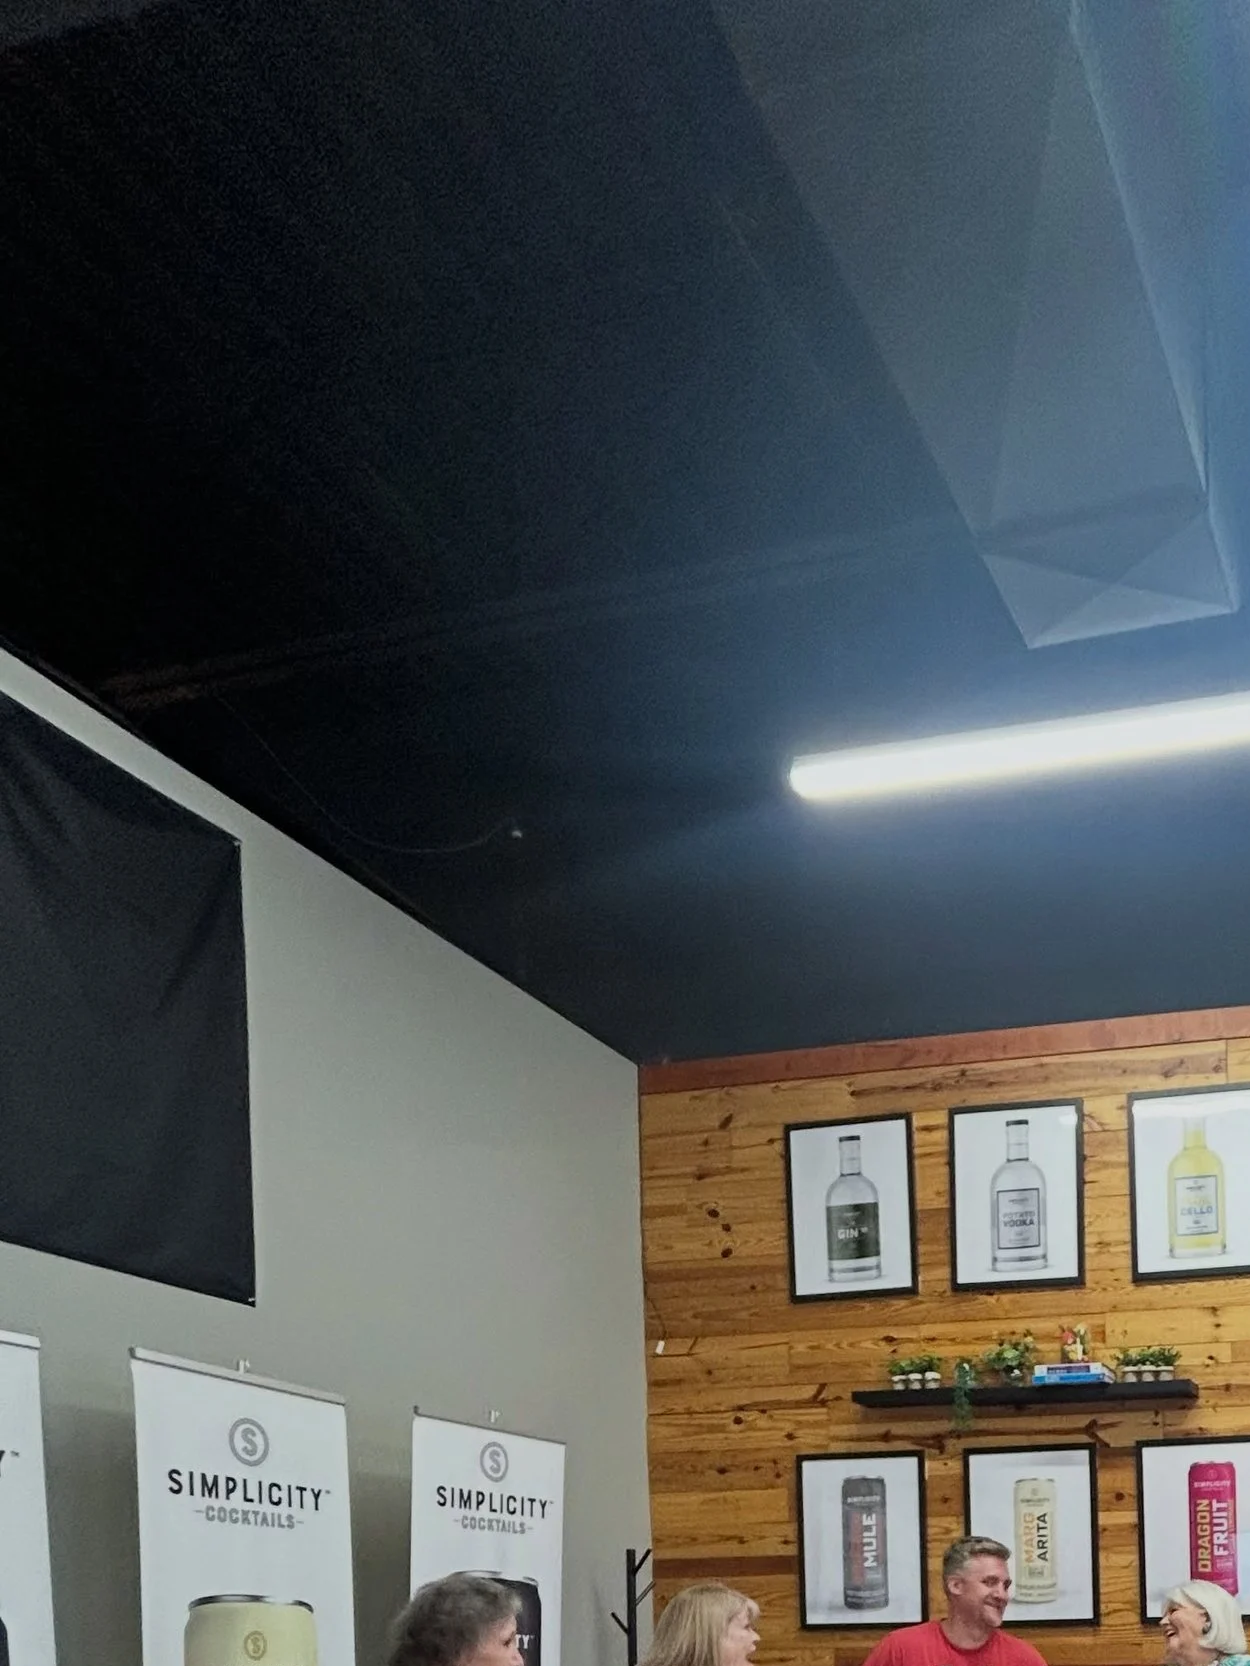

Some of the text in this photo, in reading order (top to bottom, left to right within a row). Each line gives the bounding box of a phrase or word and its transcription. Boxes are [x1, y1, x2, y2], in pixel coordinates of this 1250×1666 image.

[837, 1228, 859, 1239] GIN
[168, 1469, 322, 1511] SIMPLICITY
[436, 1485, 548, 1519] SIMPLICITY
[862, 1513, 878, 1568] MULE
[1037, 1512, 1049, 1562] ARITA
[1197, 1499, 1213, 1573] DRAGON
[1213, 1499, 1229, 1556] FRUIT
